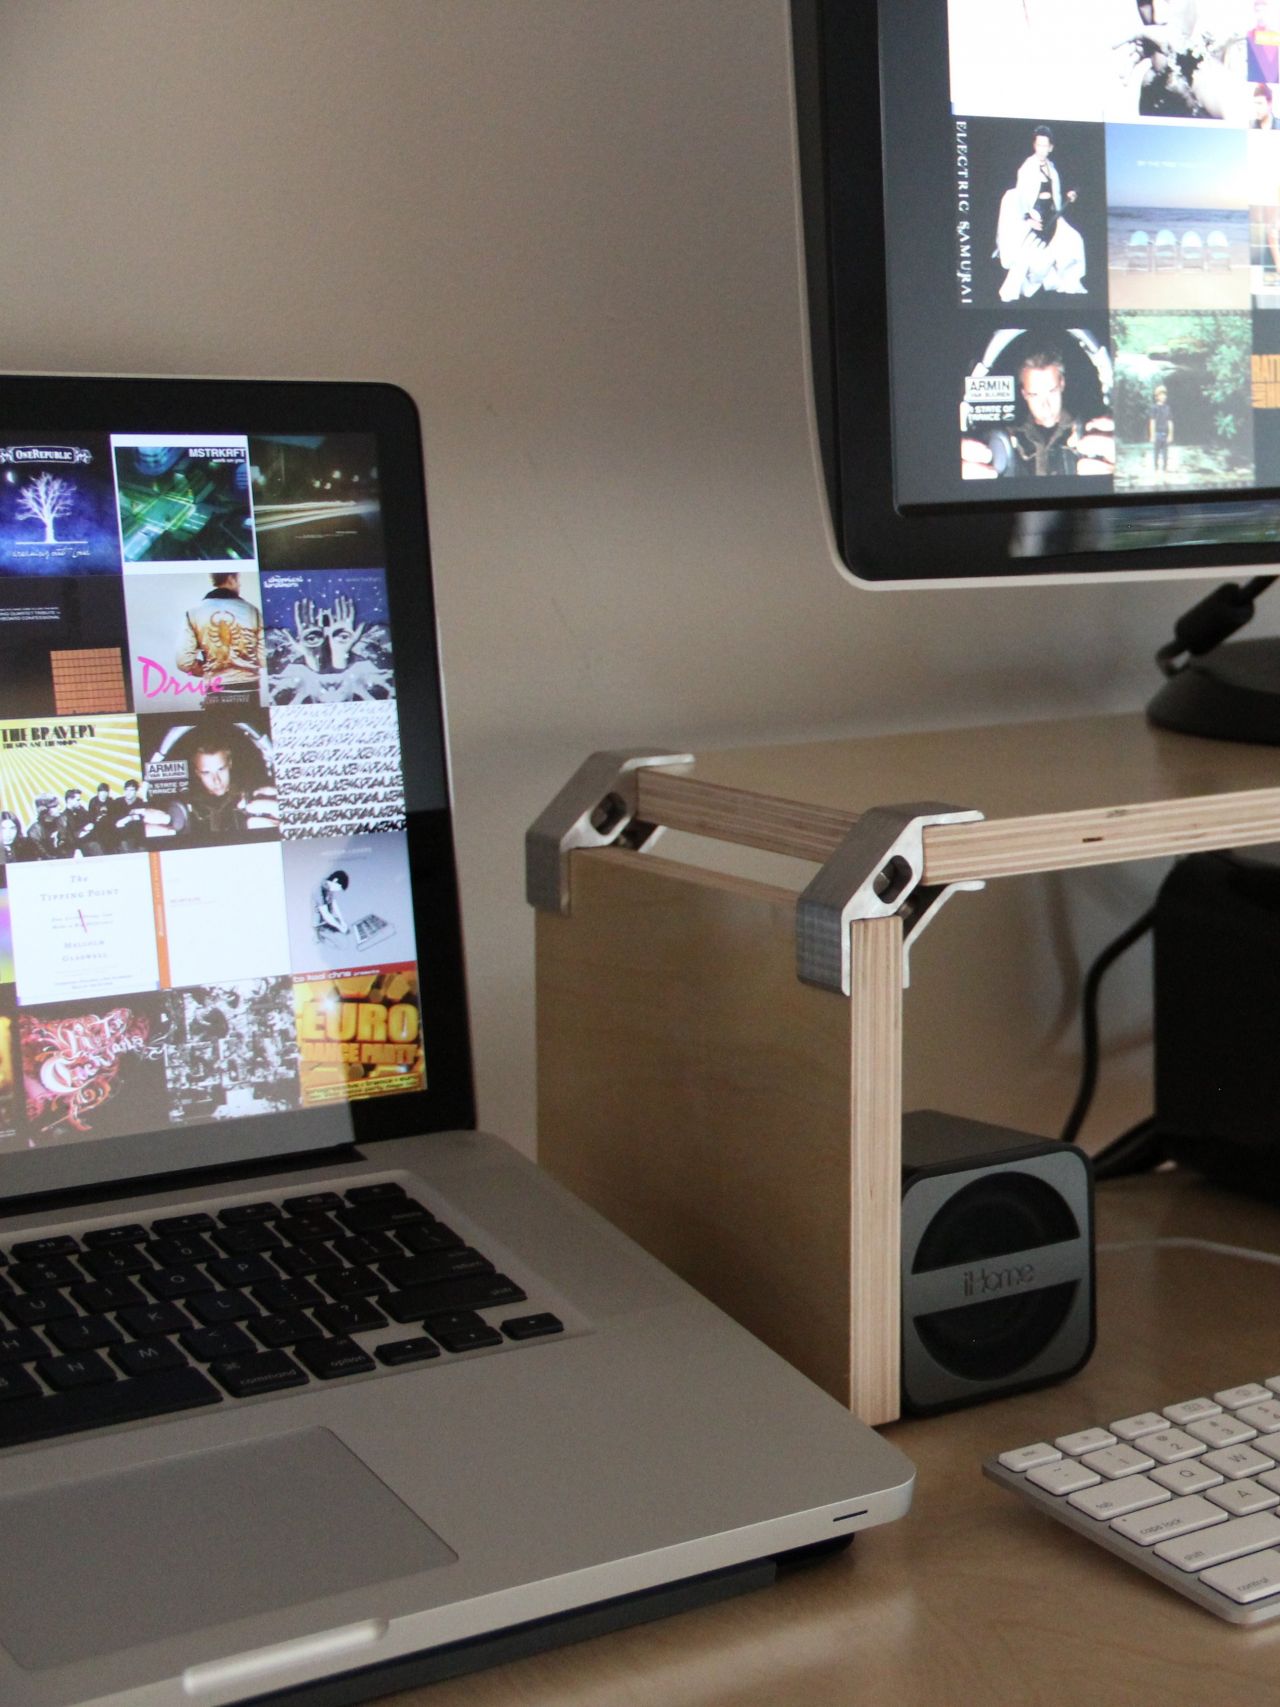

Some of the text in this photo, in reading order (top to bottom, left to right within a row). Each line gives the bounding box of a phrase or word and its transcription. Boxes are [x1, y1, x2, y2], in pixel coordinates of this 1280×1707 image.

[956, 121, 970, 214] ELECTRIC
[956, 220, 973, 304] SAMURAI
[971, 380, 1010, 391] ARMIN
[188, 448, 246, 458] MSTRKRFT
[138, 656, 225, 698] Drive
[1, 724, 96, 742] THE BRAVERY
[149, 763, 185, 773] ARMIN
[302, 1001, 419, 1041] EURO
[963, 1264, 1035, 1297] iHome
